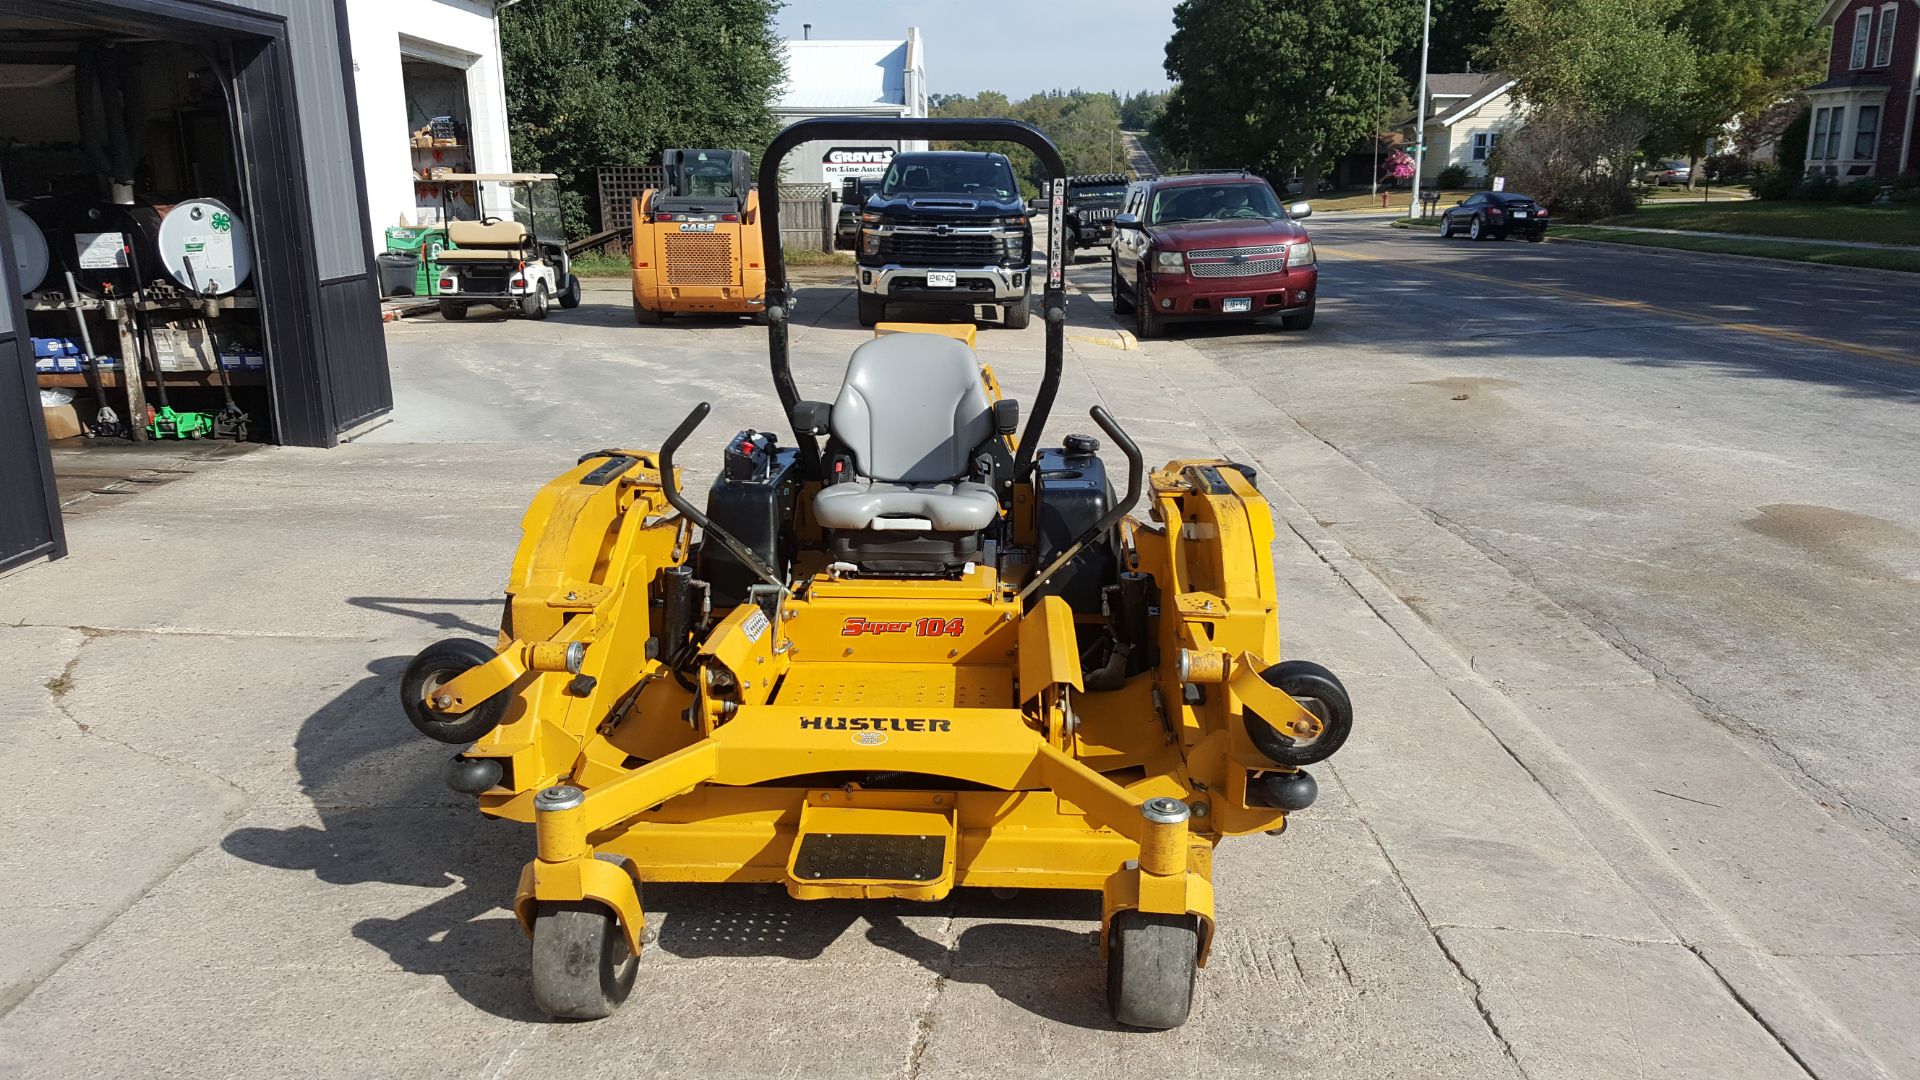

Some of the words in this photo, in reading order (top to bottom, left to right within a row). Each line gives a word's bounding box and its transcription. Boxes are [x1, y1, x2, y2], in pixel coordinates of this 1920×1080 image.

[829, 150, 894, 163] GRAVES
[840, 165, 859, 174] Line
[680, 223, 715, 232] CASE
[842, 617, 911, 636] Super
[916, 618, 964, 636] 104
[800, 716, 951, 732] HUSTLER
